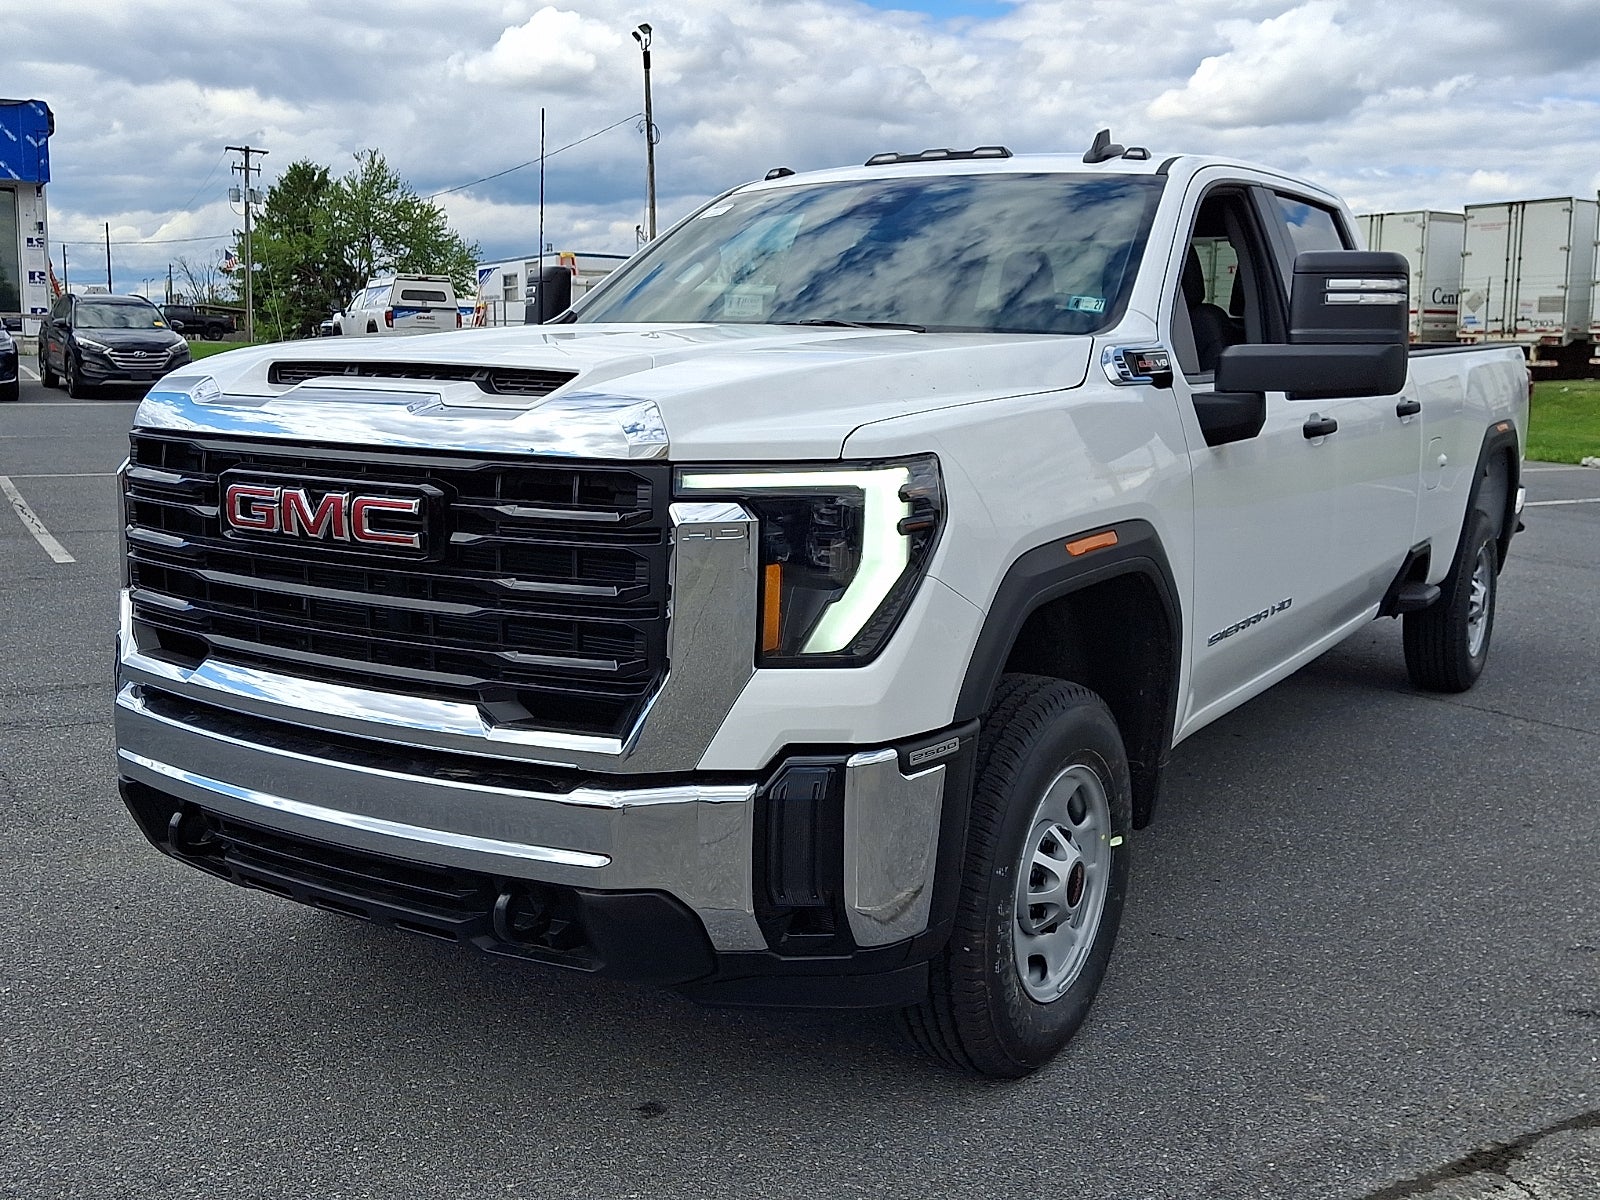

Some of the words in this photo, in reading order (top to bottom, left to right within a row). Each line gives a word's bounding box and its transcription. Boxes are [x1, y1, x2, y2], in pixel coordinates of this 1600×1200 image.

[1094, 299, 1104, 310] 27
[1156, 359, 1168, 367] V8
[226, 483, 421, 549] GMC
[682, 528, 745, 540] HD
[1207, 608, 1269, 647] SIERRA
[1270, 597, 1293, 616] HD
[912, 741, 957, 761] 2500
